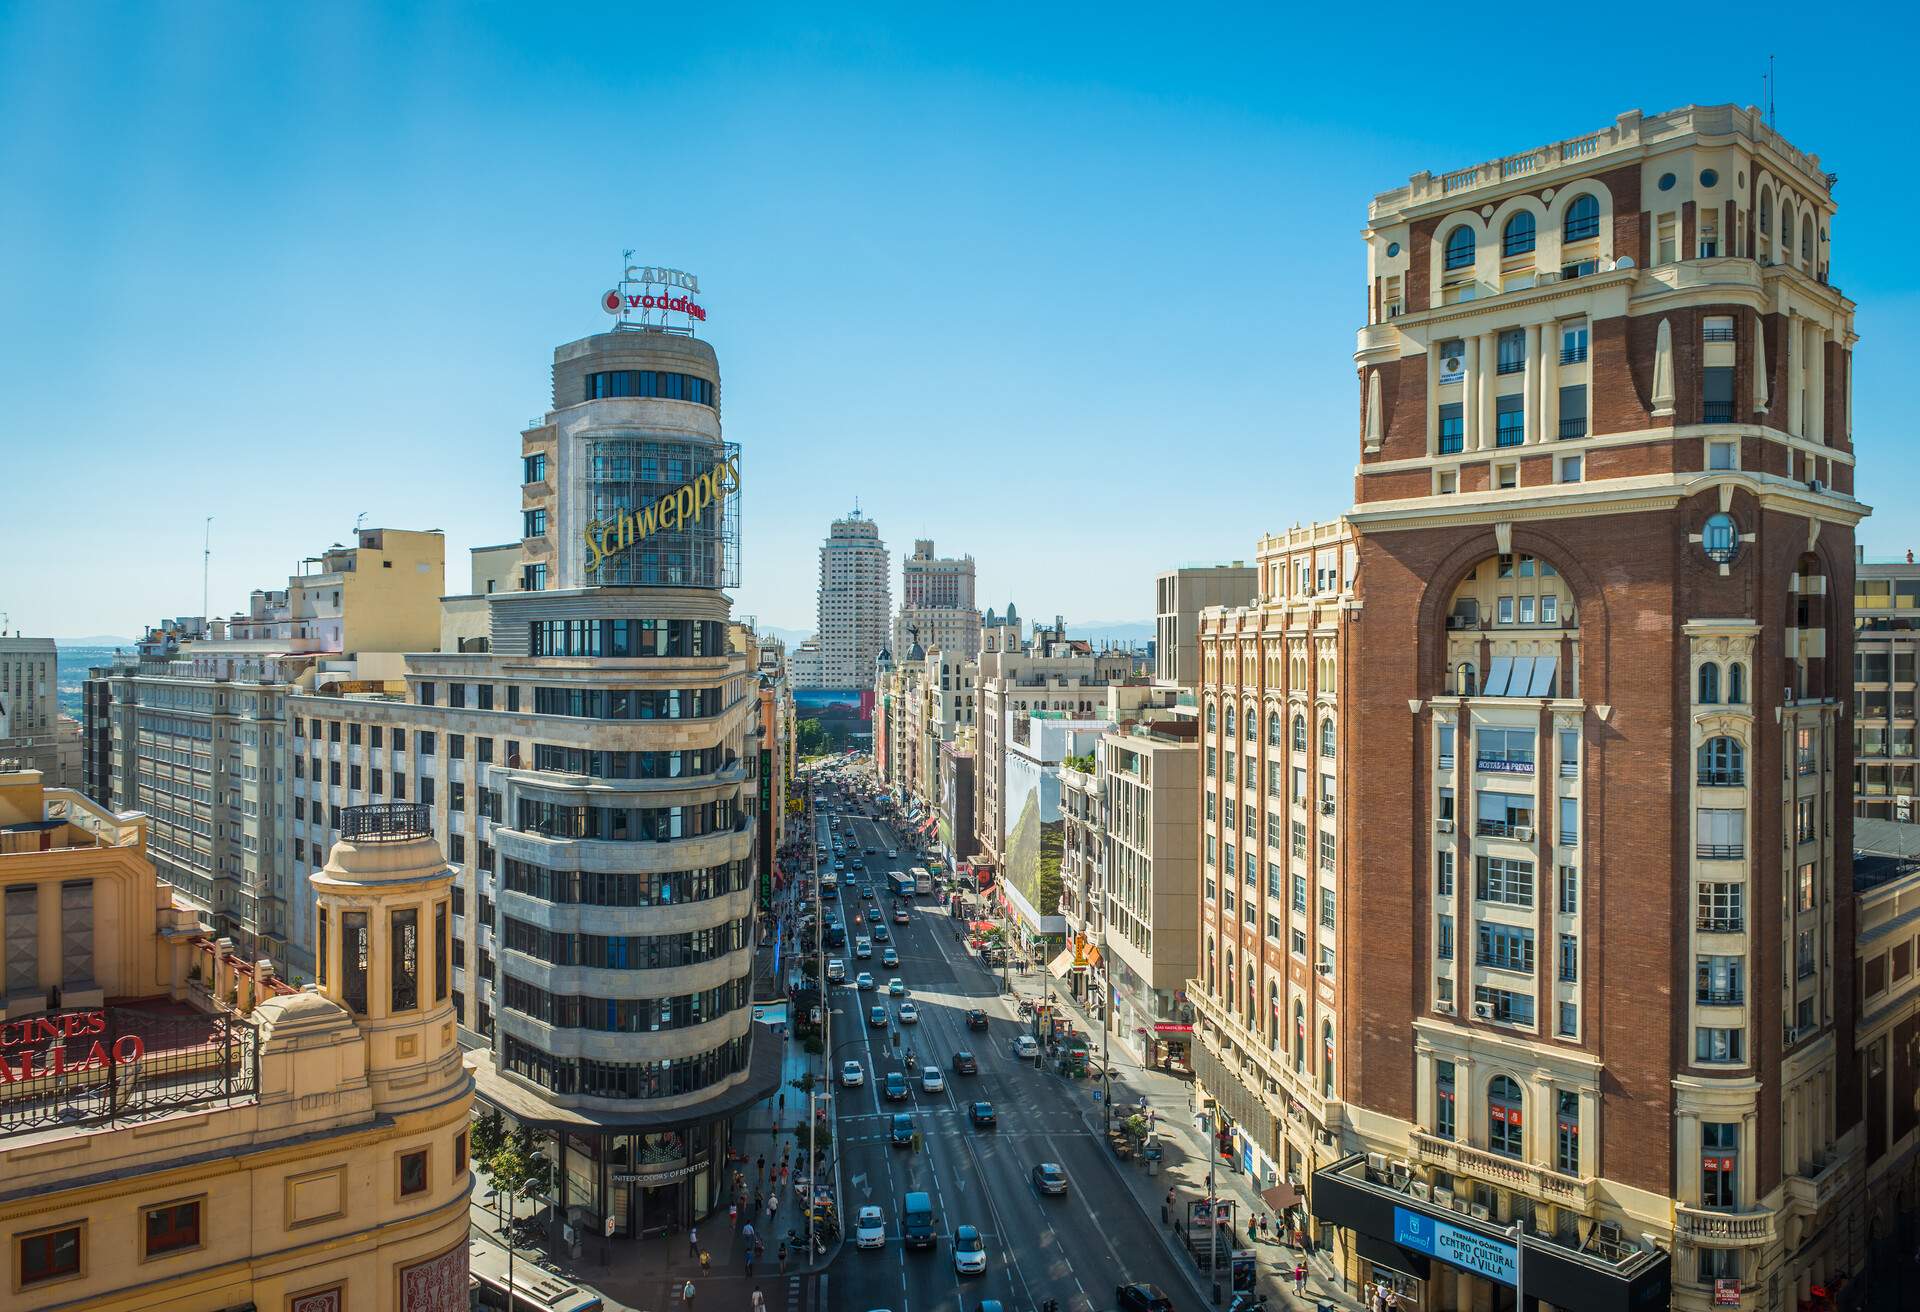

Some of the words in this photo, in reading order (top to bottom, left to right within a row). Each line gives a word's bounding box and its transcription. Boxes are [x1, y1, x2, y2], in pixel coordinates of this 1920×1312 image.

[626, 266, 701, 294] CAPITOL
[628, 292, 706, 321] vodafone
[584, 453, 740, 574] Schweppes
[762, 753, 770, 811] HOTEL
[1510, 763, 1534, 772] PRENSA
[762, 874, 770, 908] REX
[0, 1010, 105, 1047] CINES
[610, 1174, 636, 1182] UNITED
[637, 1173, 668, 1182] COLORS
[669, 1170, 679, 1178] OF
[679, 1159, 710, 1176] BENETTON
[1440, 1235, 1472, 1252] CENTRO
[1473, 1246, 1516, 1269] CULTURAL
[1453, 1250, 1464, 1261] DE
[1466, 1255, 1477, 1266] LA
[1478, 1259, 1503, 1276] VILLA
